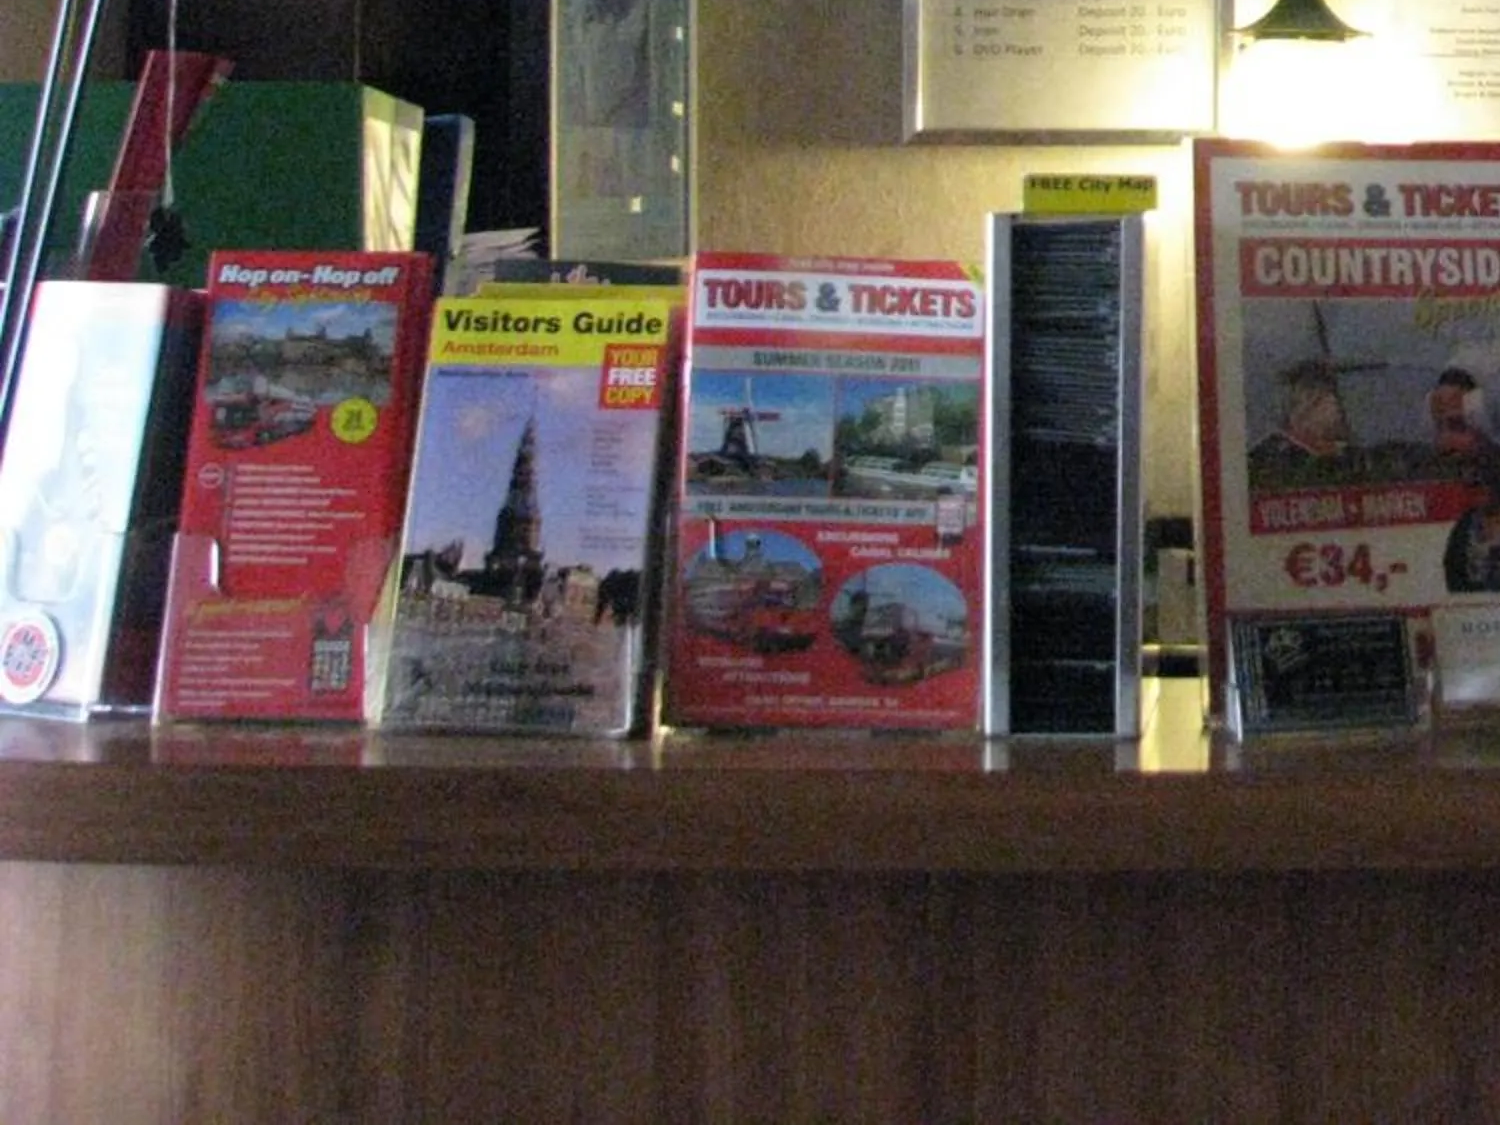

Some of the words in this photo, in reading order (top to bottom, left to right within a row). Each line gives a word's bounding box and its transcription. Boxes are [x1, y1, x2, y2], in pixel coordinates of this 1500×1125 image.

[1030, 177, 1073, 191] FREE
[1078, 178, 1112, 194] City
[1118, 176, 1154, 192] Map
[1235, 181, 1355, 217] TOURS
[1362, 183, 1392, 217] &
[218, 263, 268, 288] Hop
[311, 265, 361, 289] Hop
[362, 266, 401, 285] off
[703, 278, 808, 312] TOURS
[814, 281, 841, 313] &
[847, 283, 978, 319] TICKETS
[444, 309, 562, 335] Visitors
[572, 311, 663, 336] Guide
[442, 340, 560, 357] Amsterdam
[611, 349, 658, 367] YOUR
[607, 367, 657, 387] FREE
[605, 386, 653, 405] COPY
